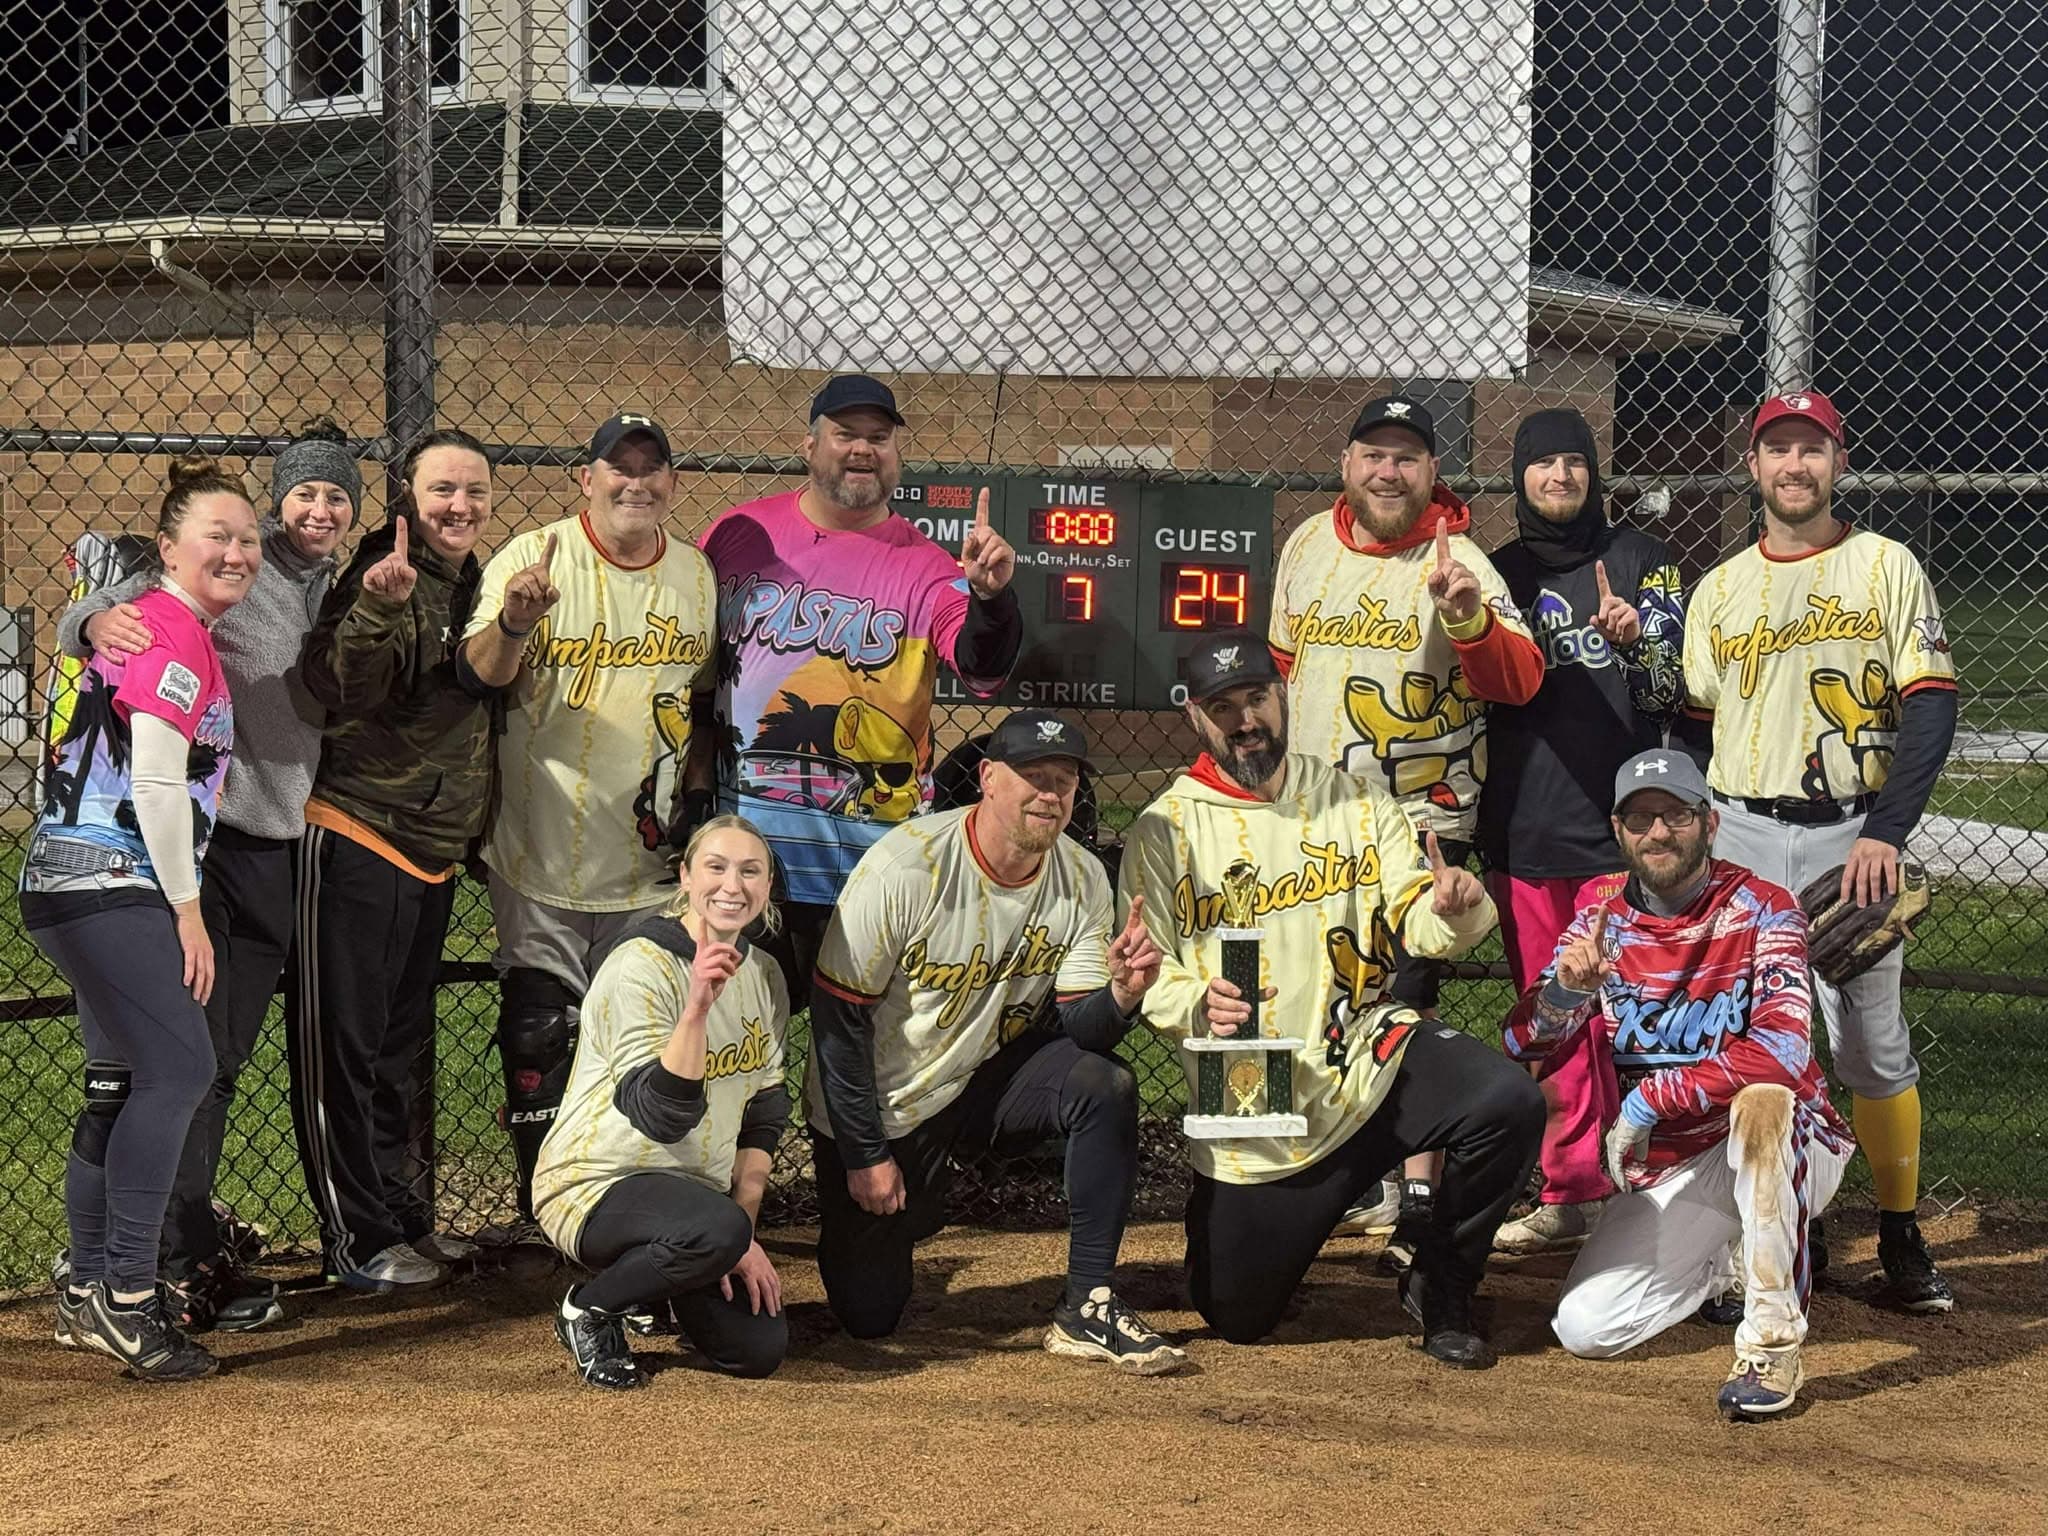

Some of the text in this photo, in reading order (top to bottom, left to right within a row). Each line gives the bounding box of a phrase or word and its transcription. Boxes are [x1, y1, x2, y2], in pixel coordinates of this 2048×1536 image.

[927, 485, 973, 498] MOBILE
[927, 497, 973, 509] SCORE
[1042, 483, 1106, 506] TIME
[905, 517, 977, 541] OME
[1050, 512, 1114, 544] 0:00
[1155, 527, 1257, 553] GUEST
[1066, 576, 1093, 620] 7
[1174, 569, 1245, 625] 24
[719, 572, 905, 669] MPASTAS
[527, 612, 710, 710] Impastas
[1018, 681, 1116, 703] STRIKE
[1613, 978, 1750, 1060] Kings
[89, 1080, 120, 1090] ACE
[511, 1106, 560, 1123] EAST
